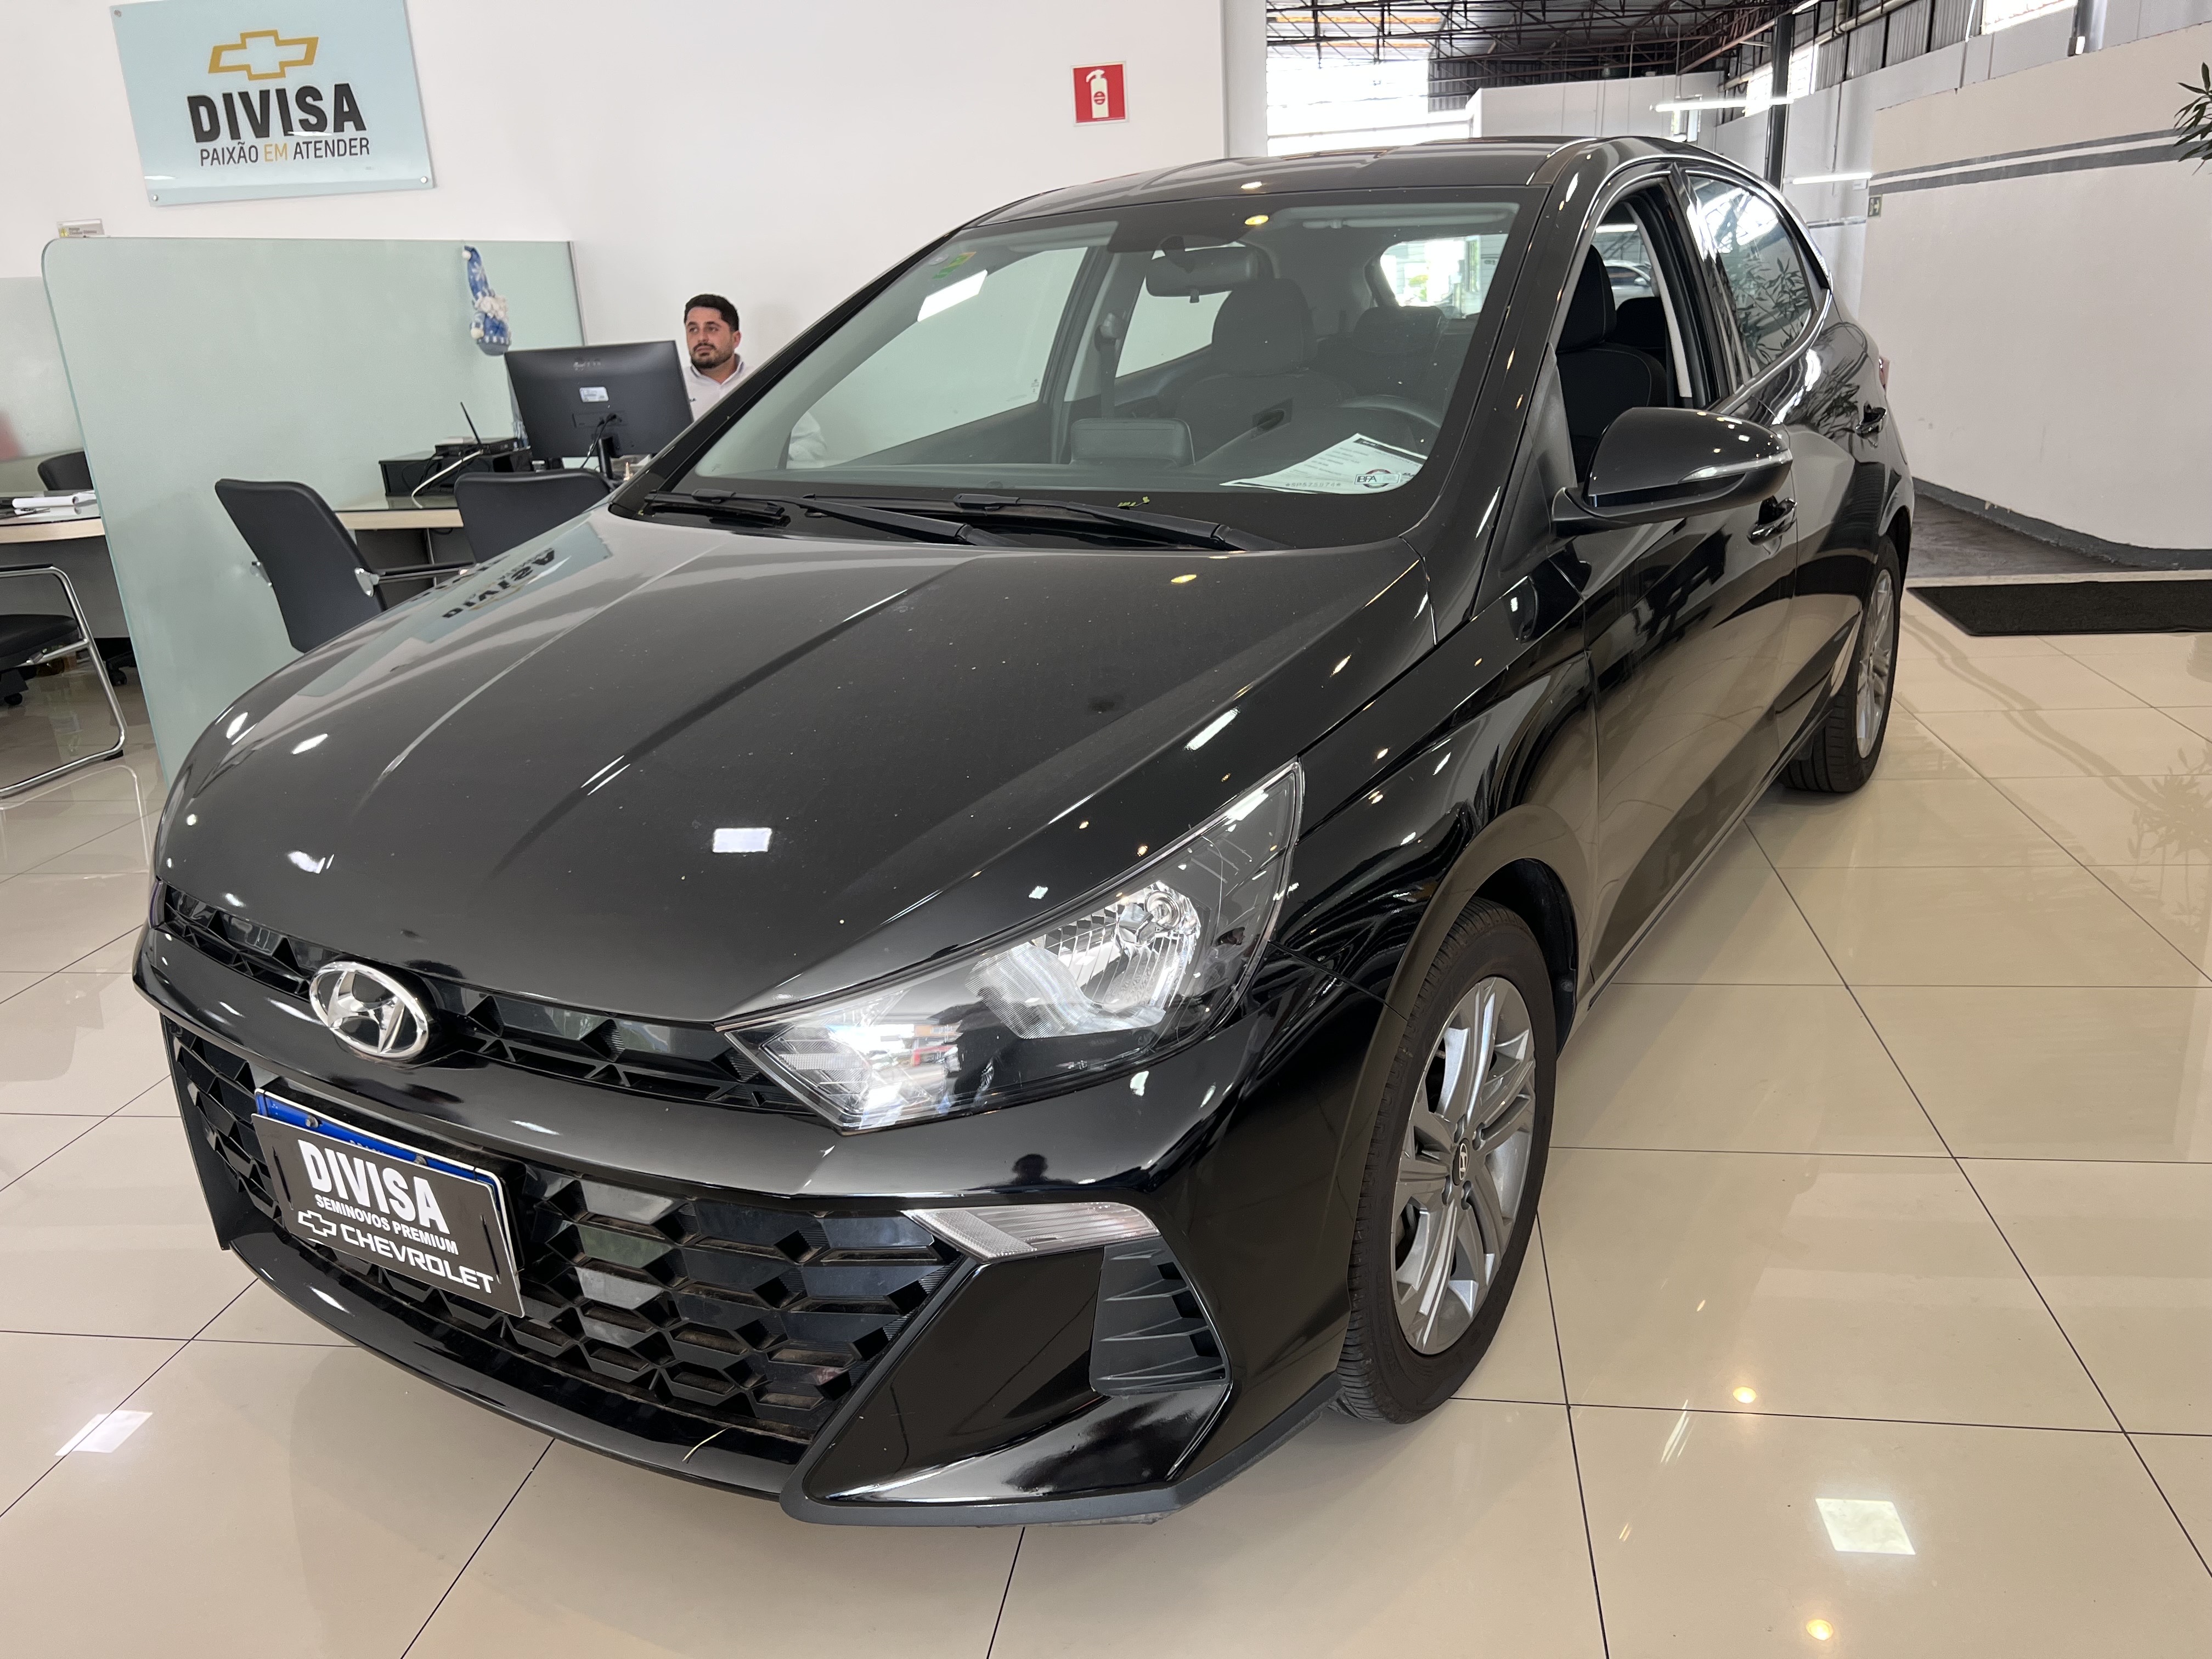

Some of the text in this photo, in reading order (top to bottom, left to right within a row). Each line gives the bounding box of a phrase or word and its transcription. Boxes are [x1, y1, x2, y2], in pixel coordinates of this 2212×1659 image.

[187, 83, 366, 143] DIVISA
[200, 137, 370, 166] PAIXÃO EM ATENDER
[298, 1139, 450, 1234] DIVISA
[315, 1194, 459, 1255] SEMINOVOS PREMIUM
[339, 1223, 494, 1294] CHEVROLET
